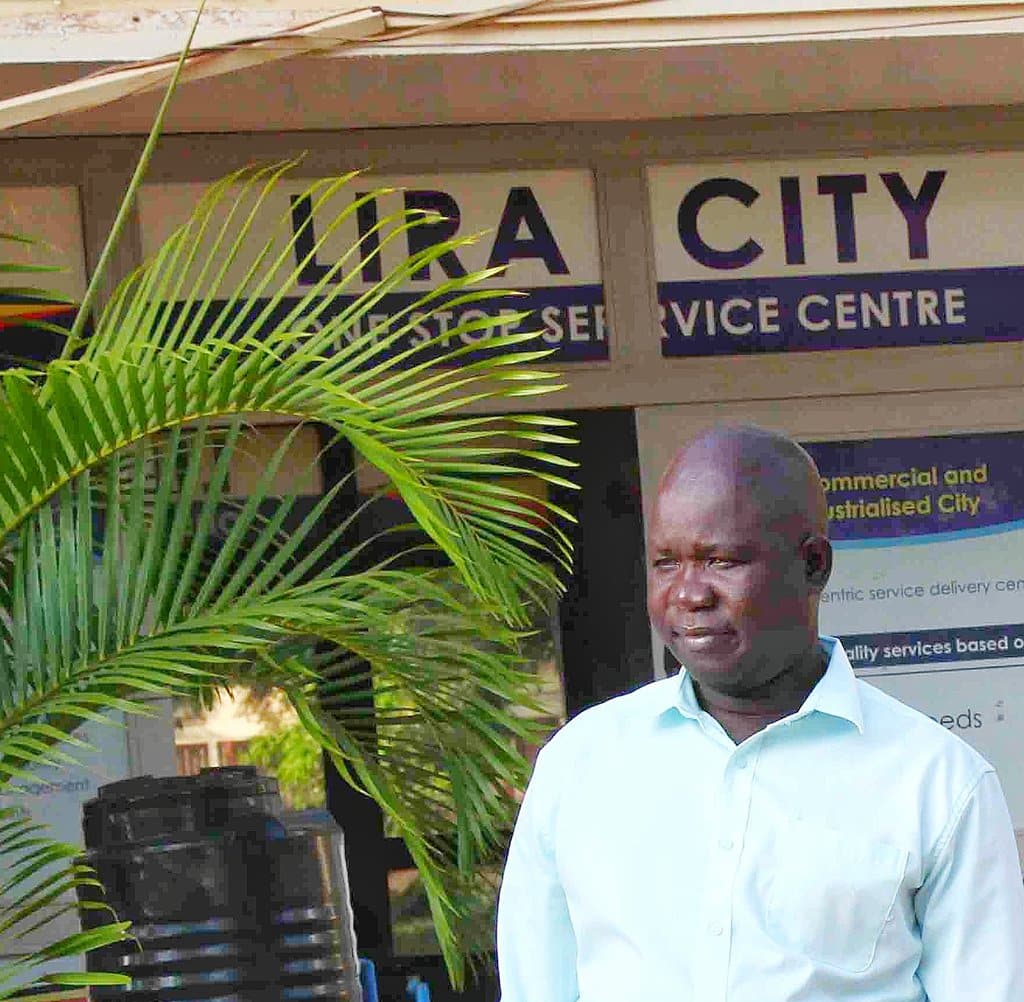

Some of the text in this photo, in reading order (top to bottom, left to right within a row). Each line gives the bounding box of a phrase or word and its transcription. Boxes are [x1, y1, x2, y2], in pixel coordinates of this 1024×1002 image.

[291, 170, 947, 284] LIRA CITY
[411, 310, 521, 347] STOP
[797, 288, 966, 333] CENTRE
[943, 464, 988, 485] and
[938, 492, 981, 517] City
[869, 582, 924, 601] service
[930, 576, 991, 598] delivery
[883, 638, 952, 659] services
[956, 634, 1009, 654] based
